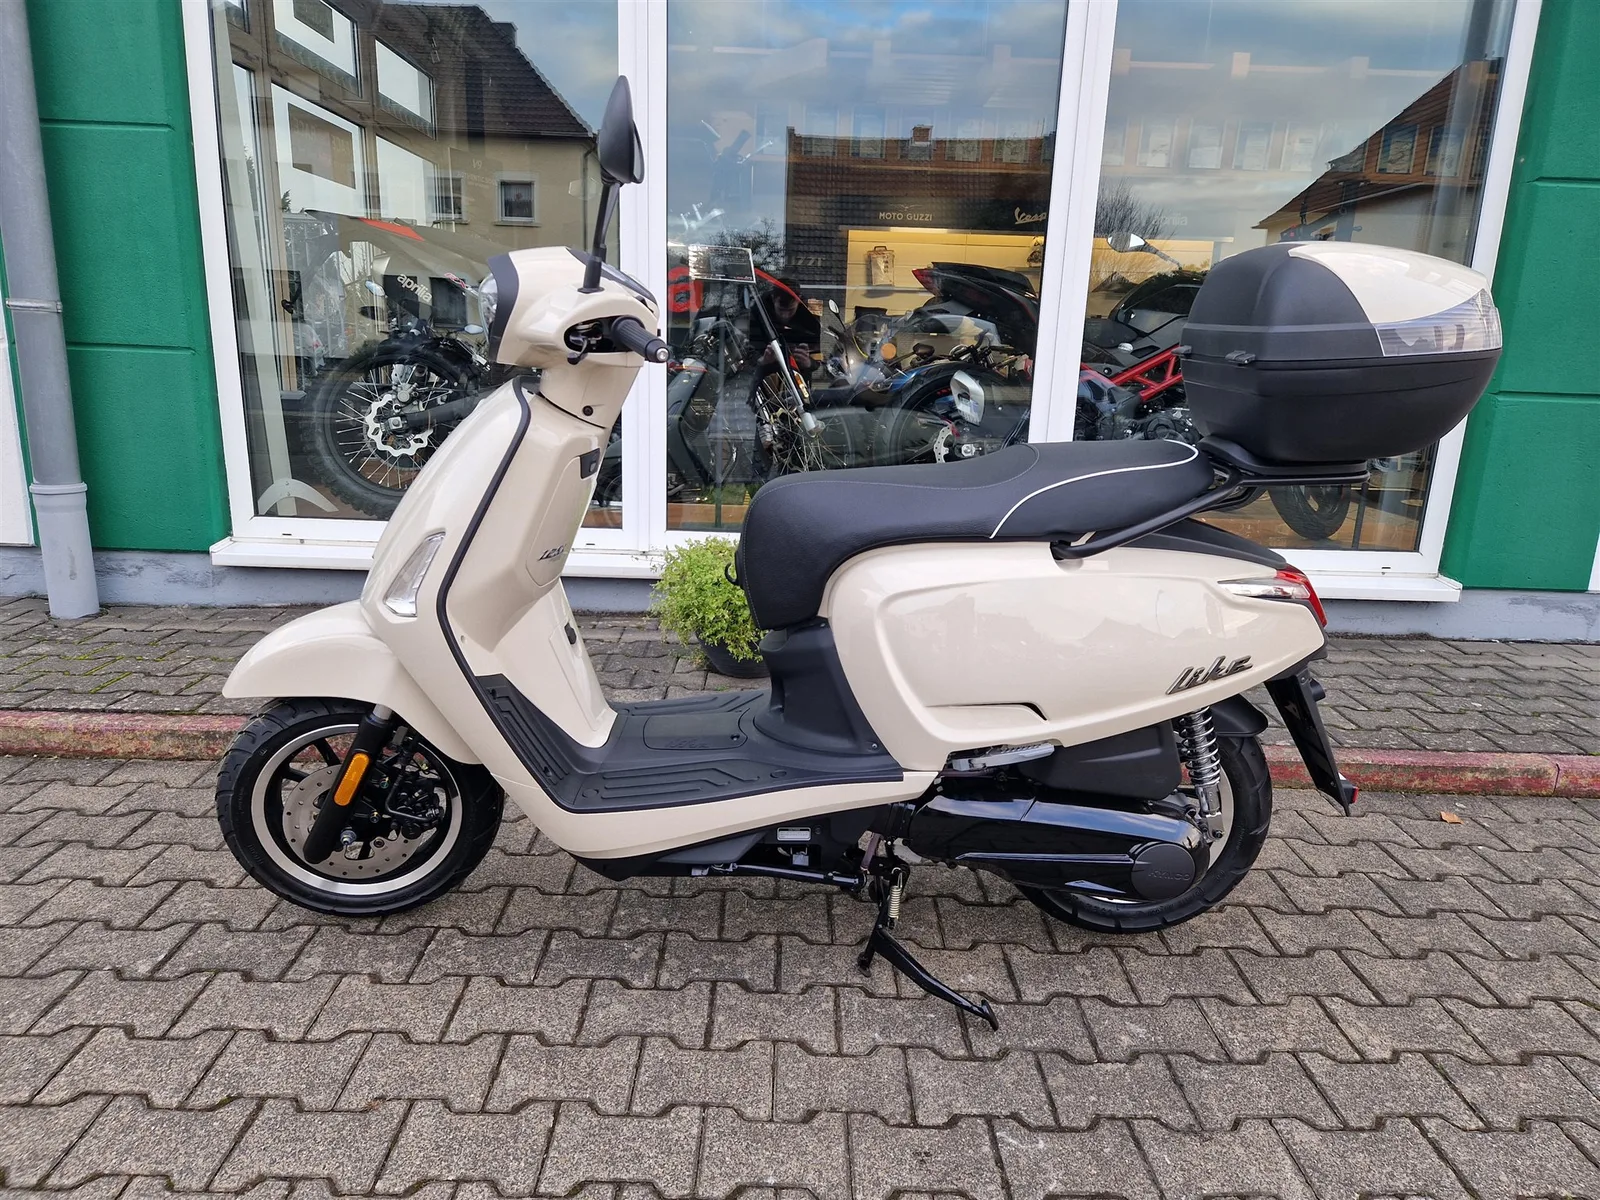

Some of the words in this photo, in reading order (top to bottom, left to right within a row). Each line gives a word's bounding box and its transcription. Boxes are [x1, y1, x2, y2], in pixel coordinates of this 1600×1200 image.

[879, 212, 904, 221] MOTO
[906, 213, 932, 222] GUZZI
[1014, 206, 1048, 225] Vesp
[397, 274, 432, 302] aprilia
[1165, 655, 1253, 695] Like
